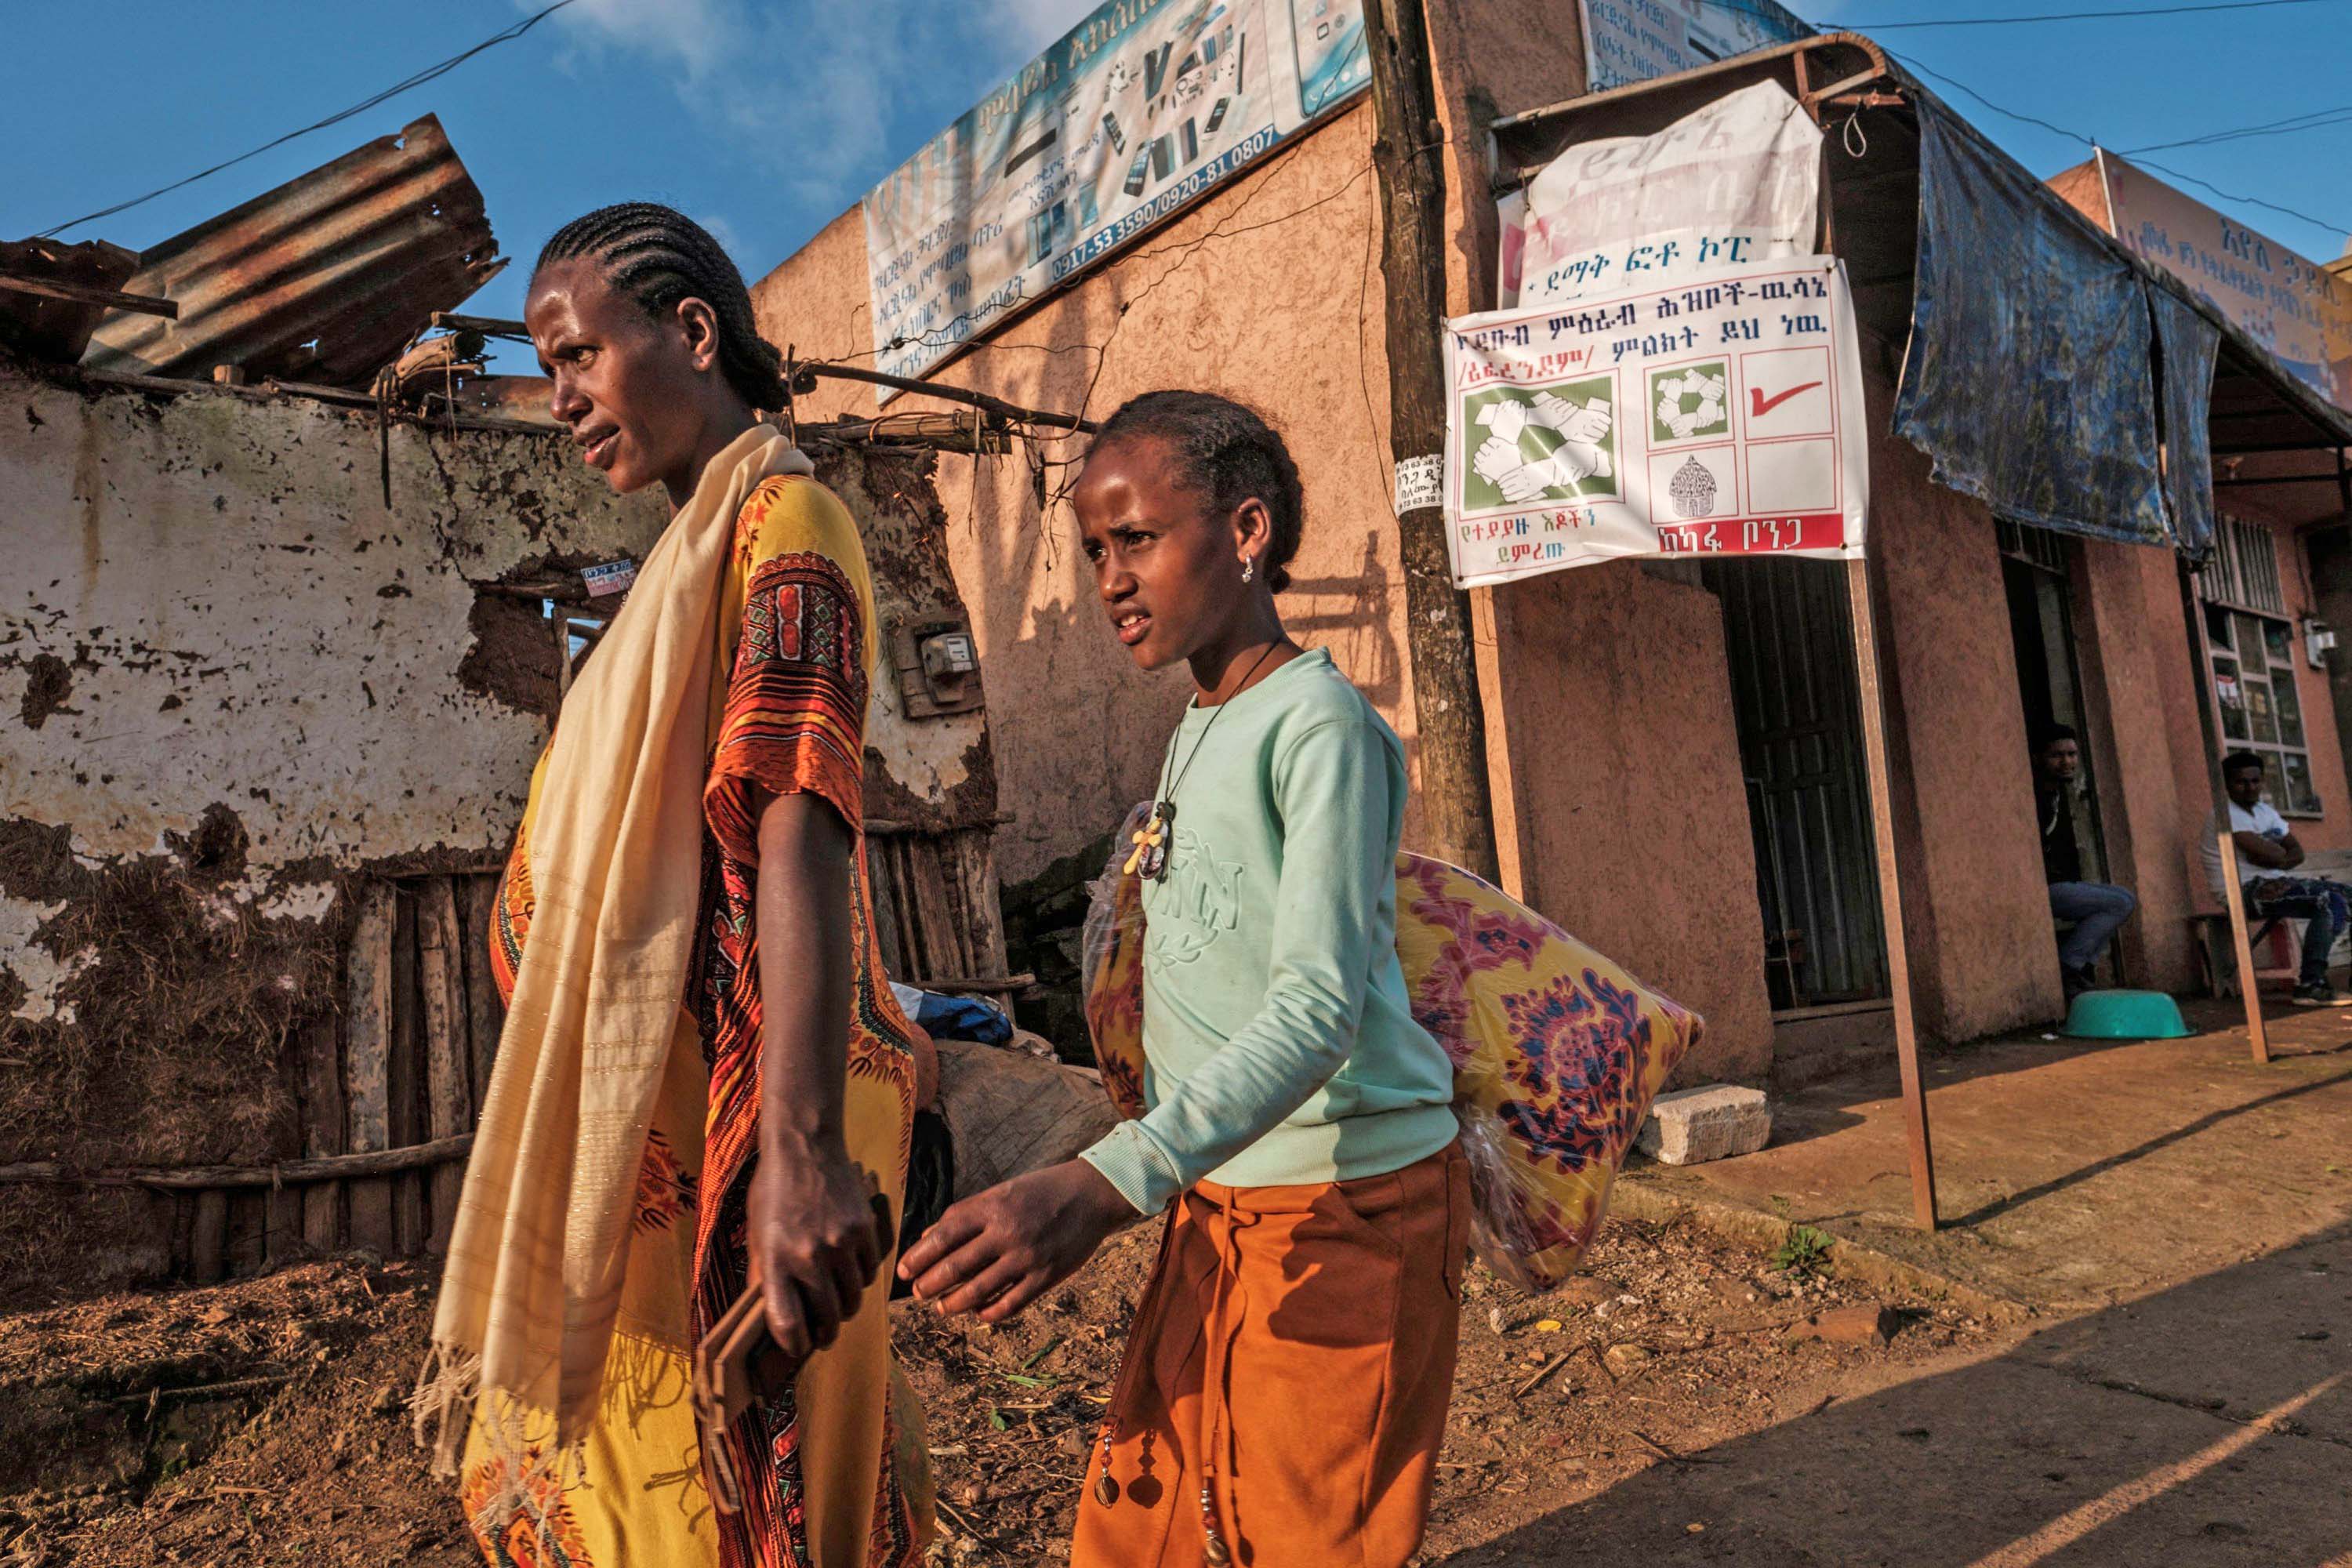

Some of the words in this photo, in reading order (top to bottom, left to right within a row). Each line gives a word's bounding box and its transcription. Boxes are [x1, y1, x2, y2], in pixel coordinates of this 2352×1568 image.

[1053, 229, 1112, 278] 0917-53
[1116, 159, 1226, 240] 3590/0920-81
[1232, 124, 1275, 166] 0807
[1625, 241, 1679, 272] ፎቶ
[1698, 236, 1751, 263] ኮፒ
[1612, 328, 1699, 362] ምልክት
[1721, 318, 1760, 343] ይህ
[1781, 314, 1827, 336] ነው
[1461, 518, 1530, 543] የተያያዙ
[1742, 518, 1802, 552] ቦንጋ
[1497, 543, 1565, 567] ይምረጡ
